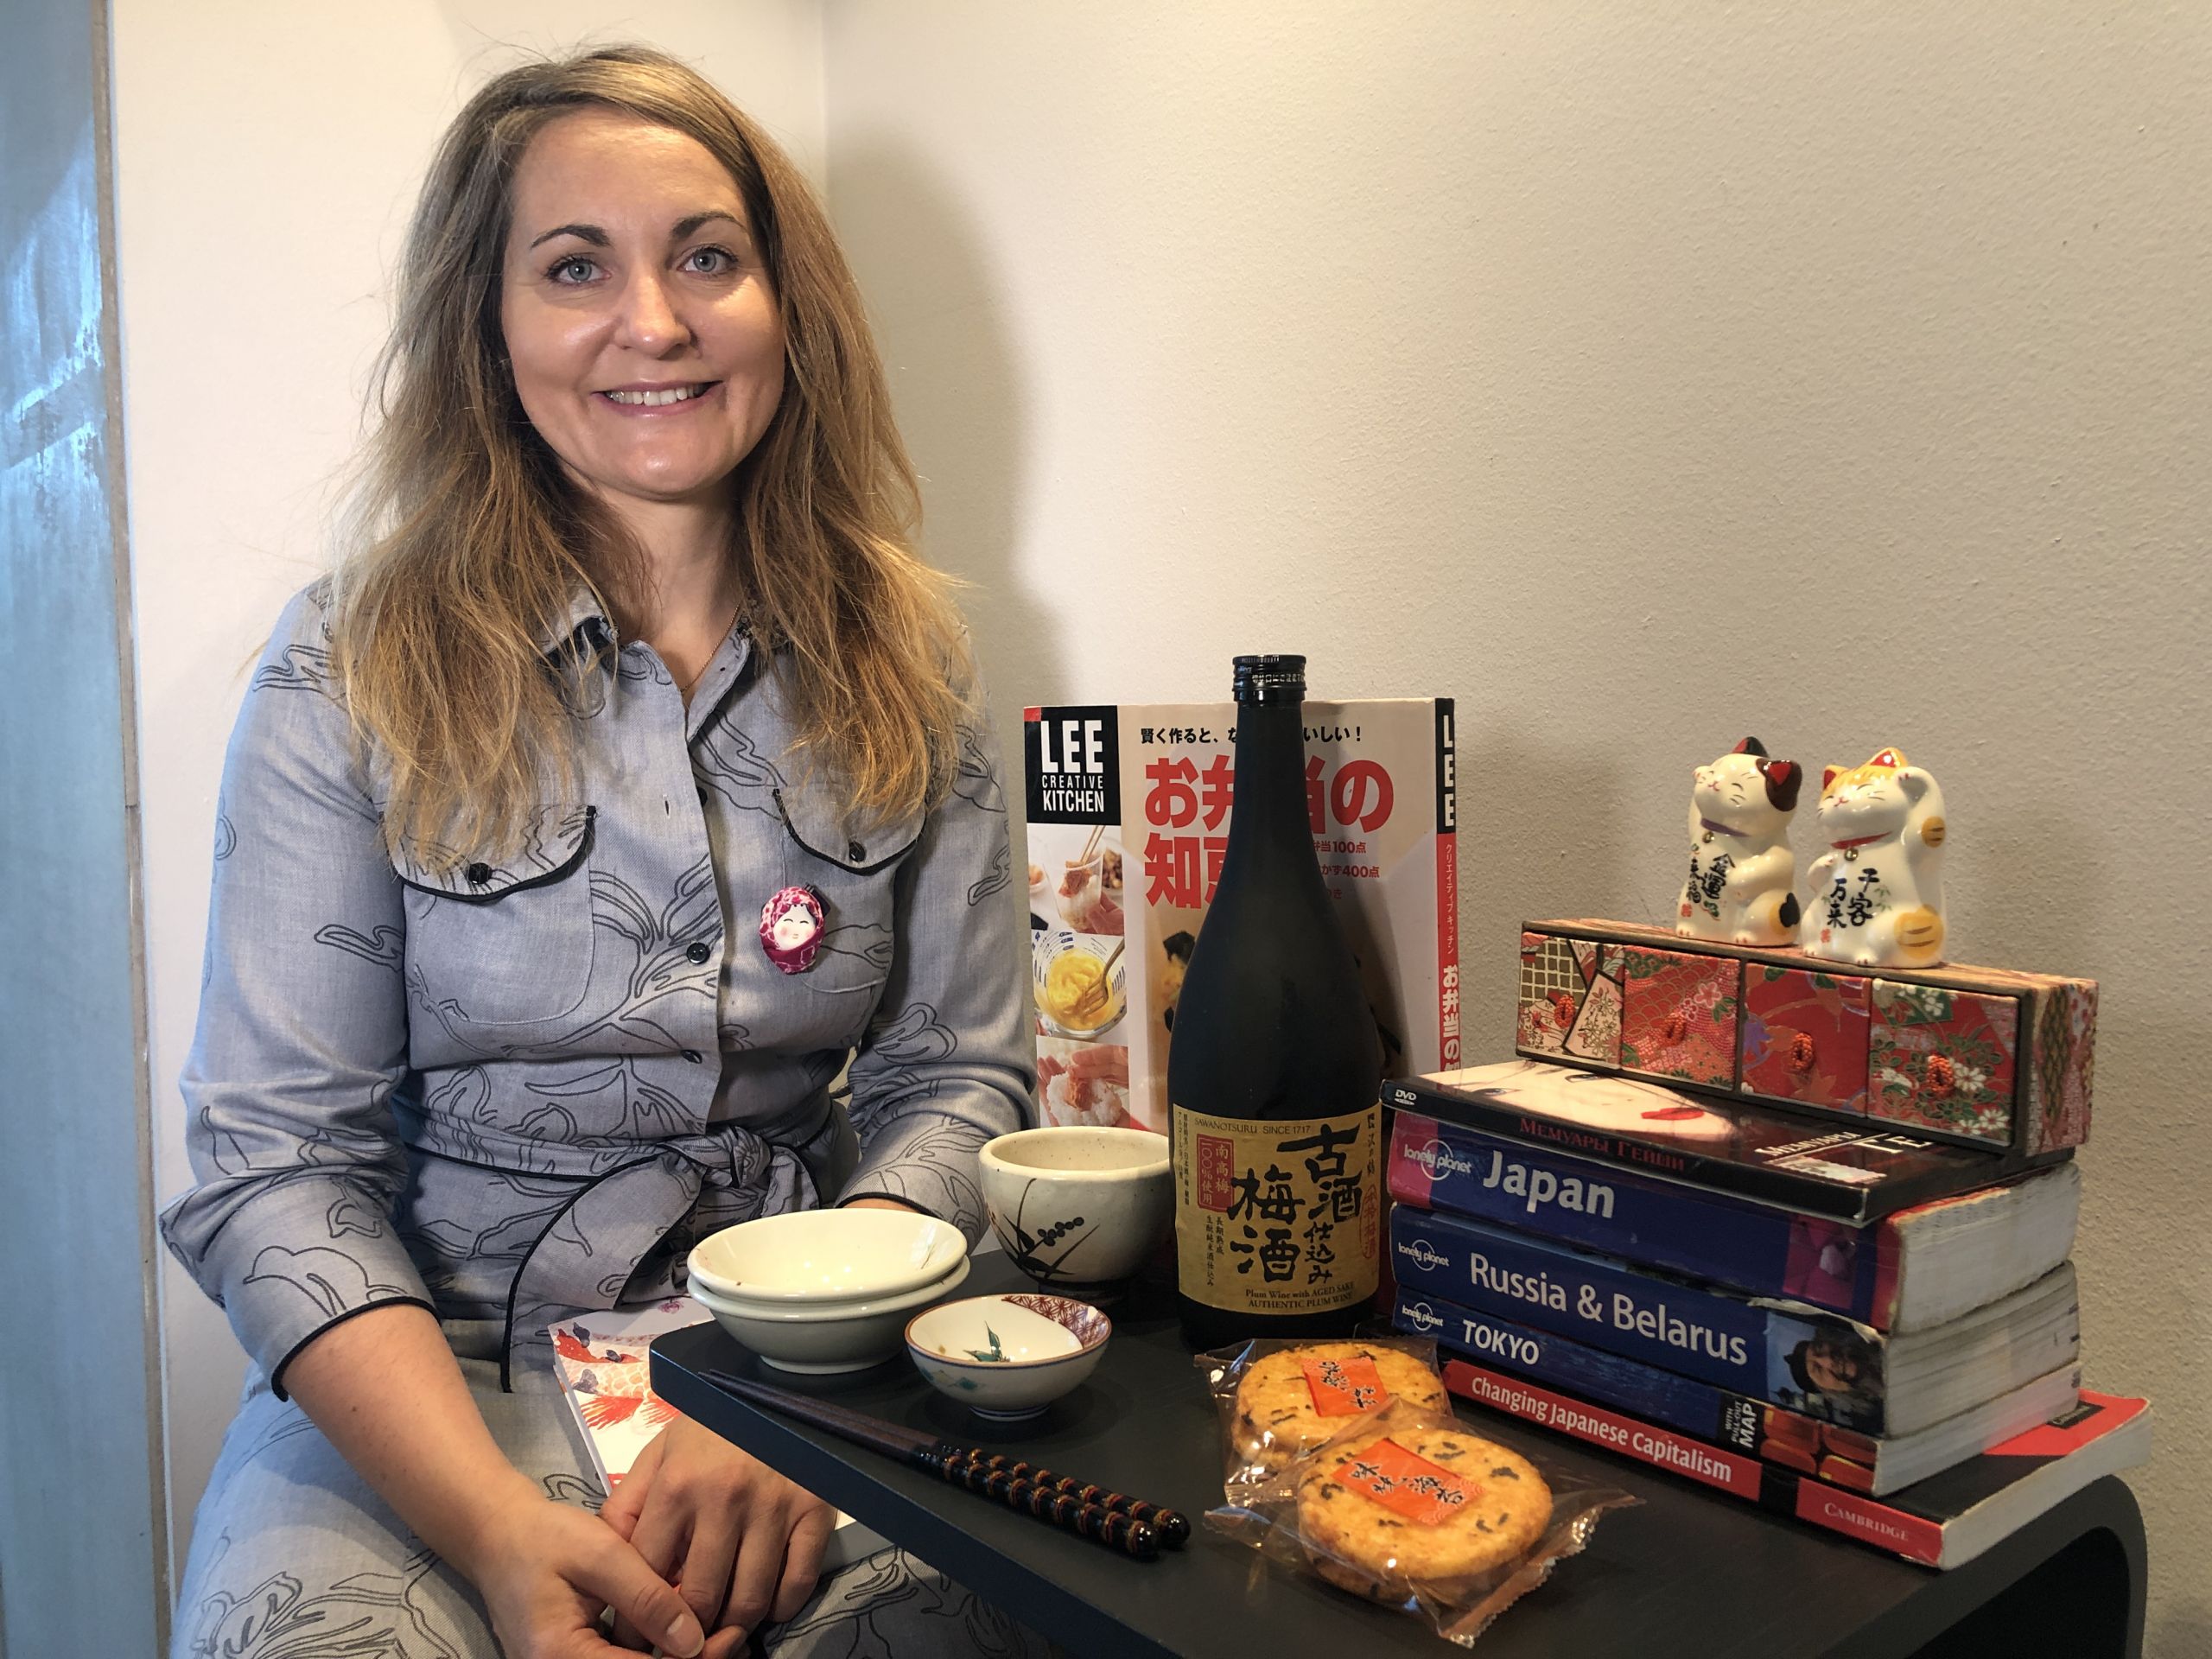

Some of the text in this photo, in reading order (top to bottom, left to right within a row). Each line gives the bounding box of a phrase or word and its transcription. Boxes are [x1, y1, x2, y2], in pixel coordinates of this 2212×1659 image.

[1040, 719, 1104, 773] LEE
[1041, 774, 1103, 789] CREATIVE
[1443, 715, 1454, 827] LEE
[1042, 790, 1104, 812] KITCHEN
[1446, 844, 1455, 954] クリエイティブ キッチン
[1827, 878, 1847, 928] 万来
[1847, 868, 1880, 927] 千客
[1395, 1089, 1417, 1101] DVD
[1195, 1118, 1311, 1134] SAWANOTSURU SINCE 1717
[1216, 1144, 1230, 1193] 南高梅
[1404, 1144, 1471, 1175] lonely planet
[1483, 1149, 1615, 1219] Japan
[1227, 1164, 1306, 1283] 梅酒
[1398, 1242, 1450, 1268] lonely planet
[1246, 1289, 1267, 1298] Plum
[1268, 1290, 1289, 1299] Wine
[1313, 1286, 1336, 1296] AGED
[1249, 1300, 1305, 1308] AUTHENTIC
[1306, 1298, 1331, 1306] PLUM
[1471, 1252, 1748, 1366] Russia & Belarus
[1402, 1305, 1444, 1327] lonely planet
[1463, 1319, 1540, 1365] TOKYO
[1471, 1376, 1732, 1482] Changing Japanese Capitalism
[1738, 1402, 1758, 1449] MAP
[1824, 1502, 1909, 1541] CAMBRIDGE
